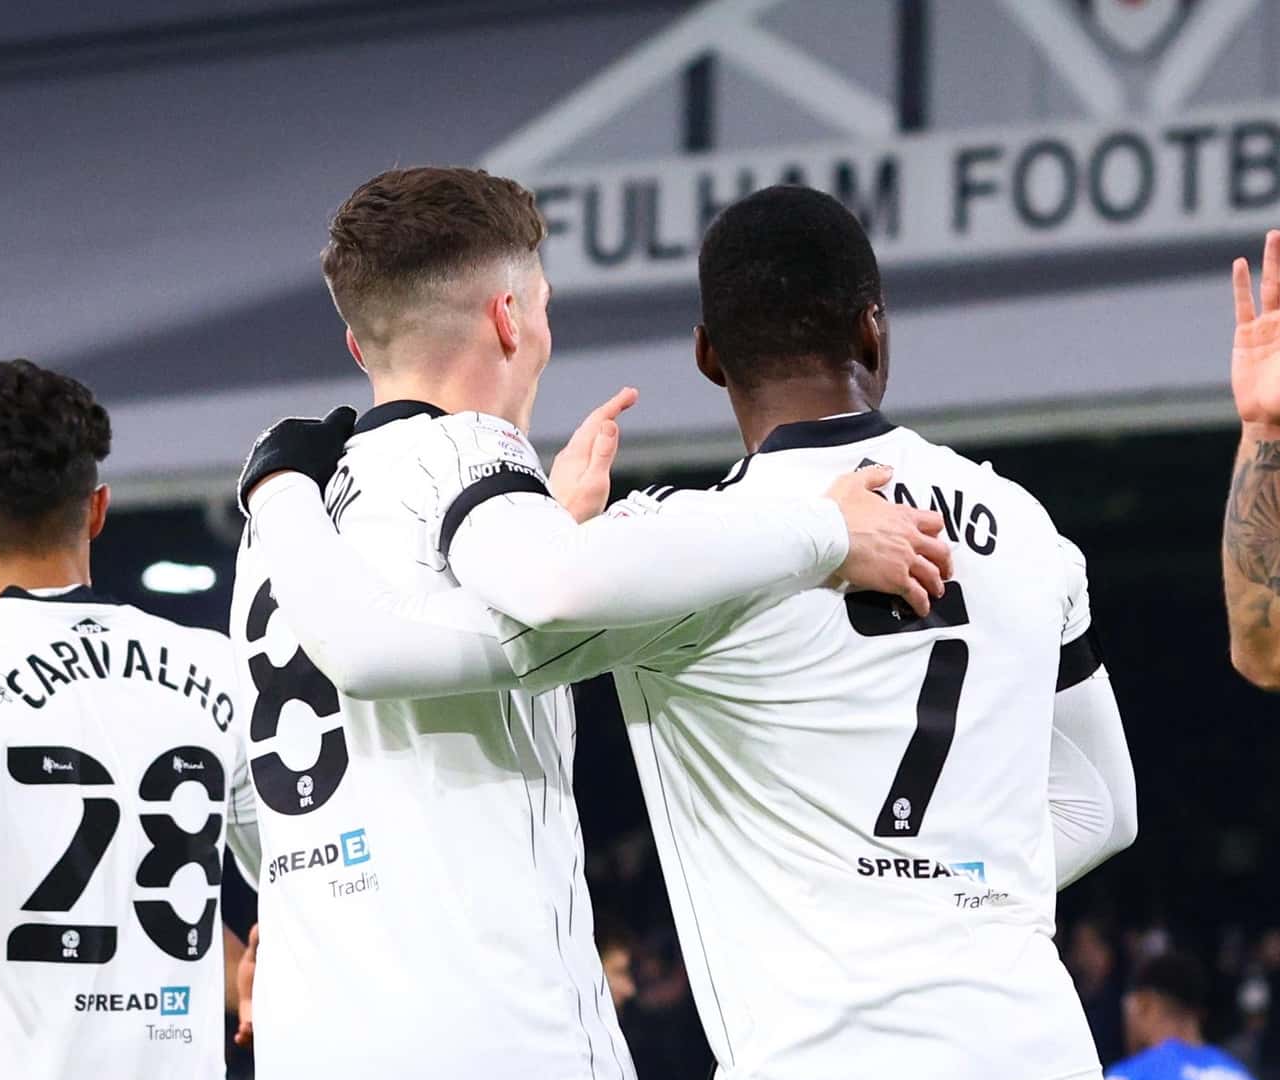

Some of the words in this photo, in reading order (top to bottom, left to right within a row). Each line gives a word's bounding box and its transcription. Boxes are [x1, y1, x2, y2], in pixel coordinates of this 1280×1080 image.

[536, 152, 901, 265] FULHM
[470, 460, 503, 481] NOT
[893, 482, 998, 556] ANO
[6, 637, 234, 732] CARVALHO
[245, 578, 349, 816] 8
[843, 579, 970, 838] 7
[6, 745, 226, 962] 28
[894, 820, 910, 830] EFL
[268, 832, 371, 884] SREADE
[857, 857, 983, 880] SPREA
[63, 948, 79, 958] EFL
[146, 1024, 193, 1044] Trading
